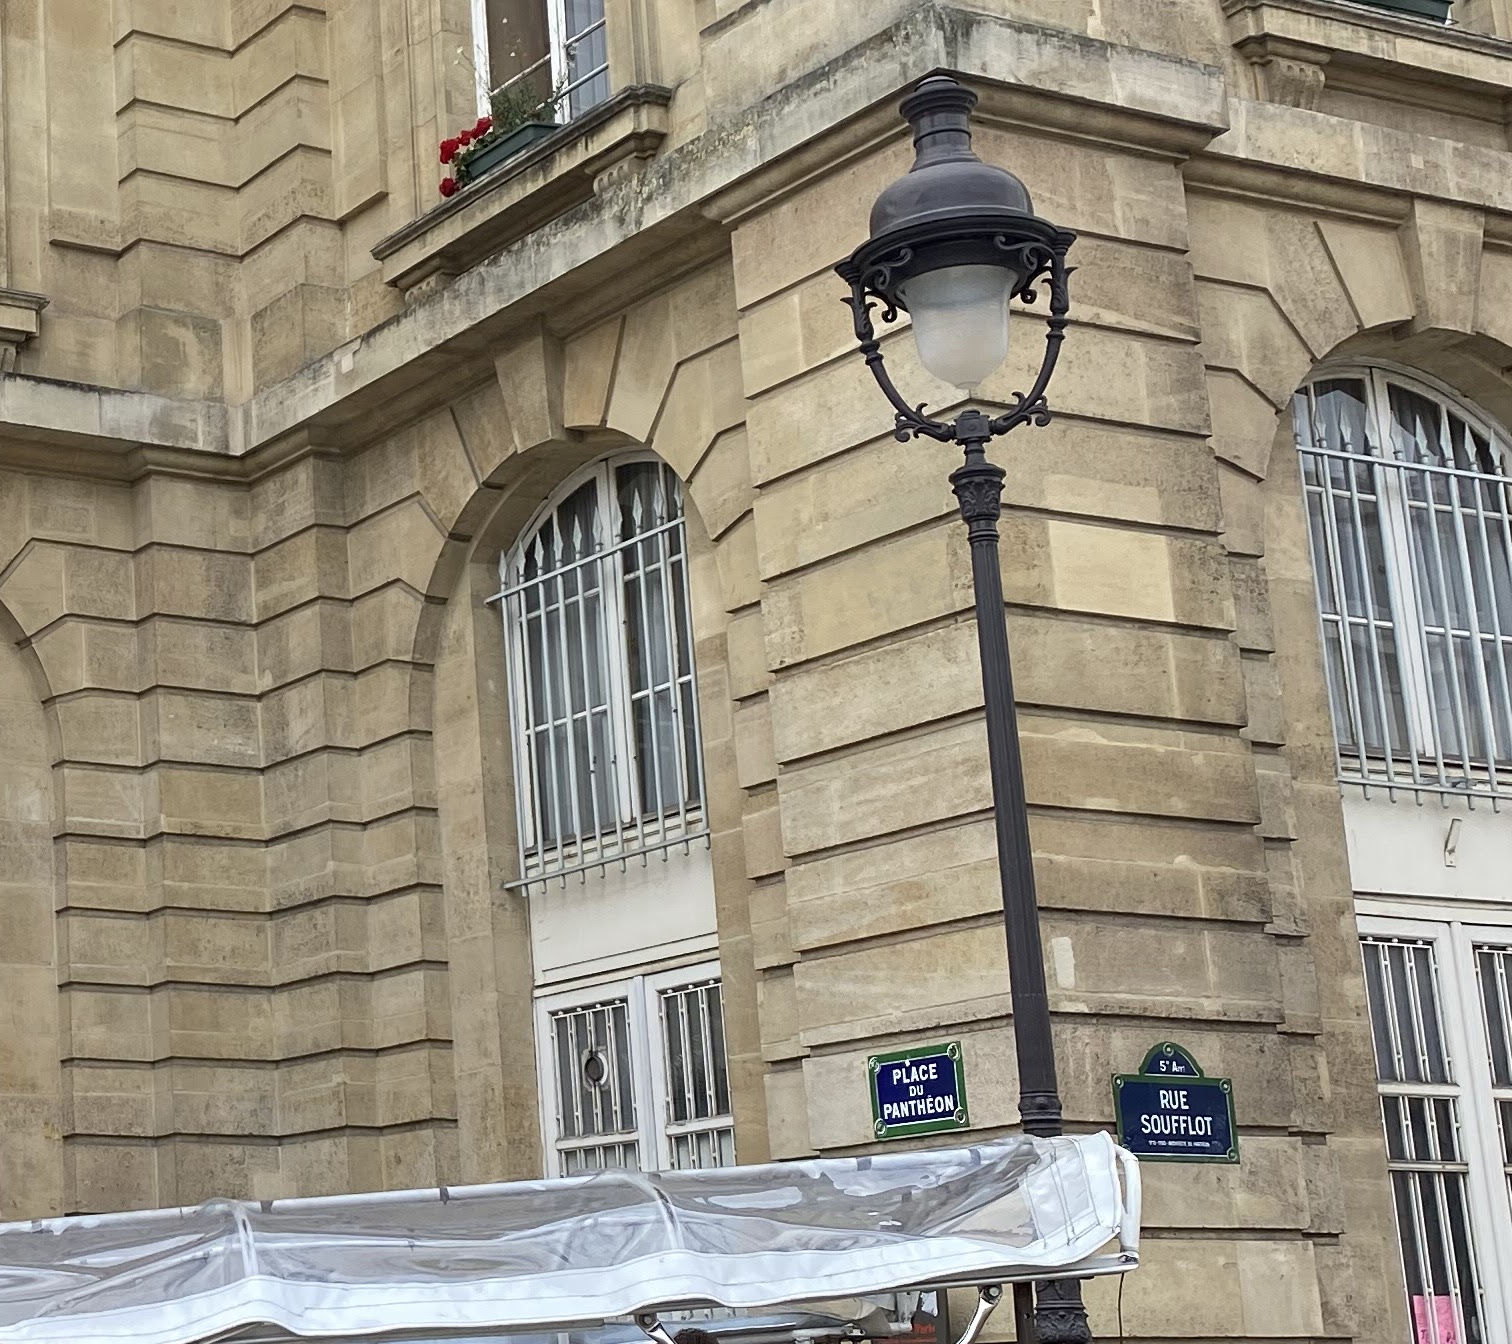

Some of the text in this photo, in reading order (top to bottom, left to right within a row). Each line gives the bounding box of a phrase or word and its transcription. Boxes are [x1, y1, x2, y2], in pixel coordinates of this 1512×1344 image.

[892, 1062, 938, 1086] PLACE
[908, 1084, 924, 1097] DU
[1159, 1089, 1190, 1110] RUE
[883, 1094, 955, 1120] PANTHÉON
[1140, 1114, 1213, 1136] SOUFFLOT
